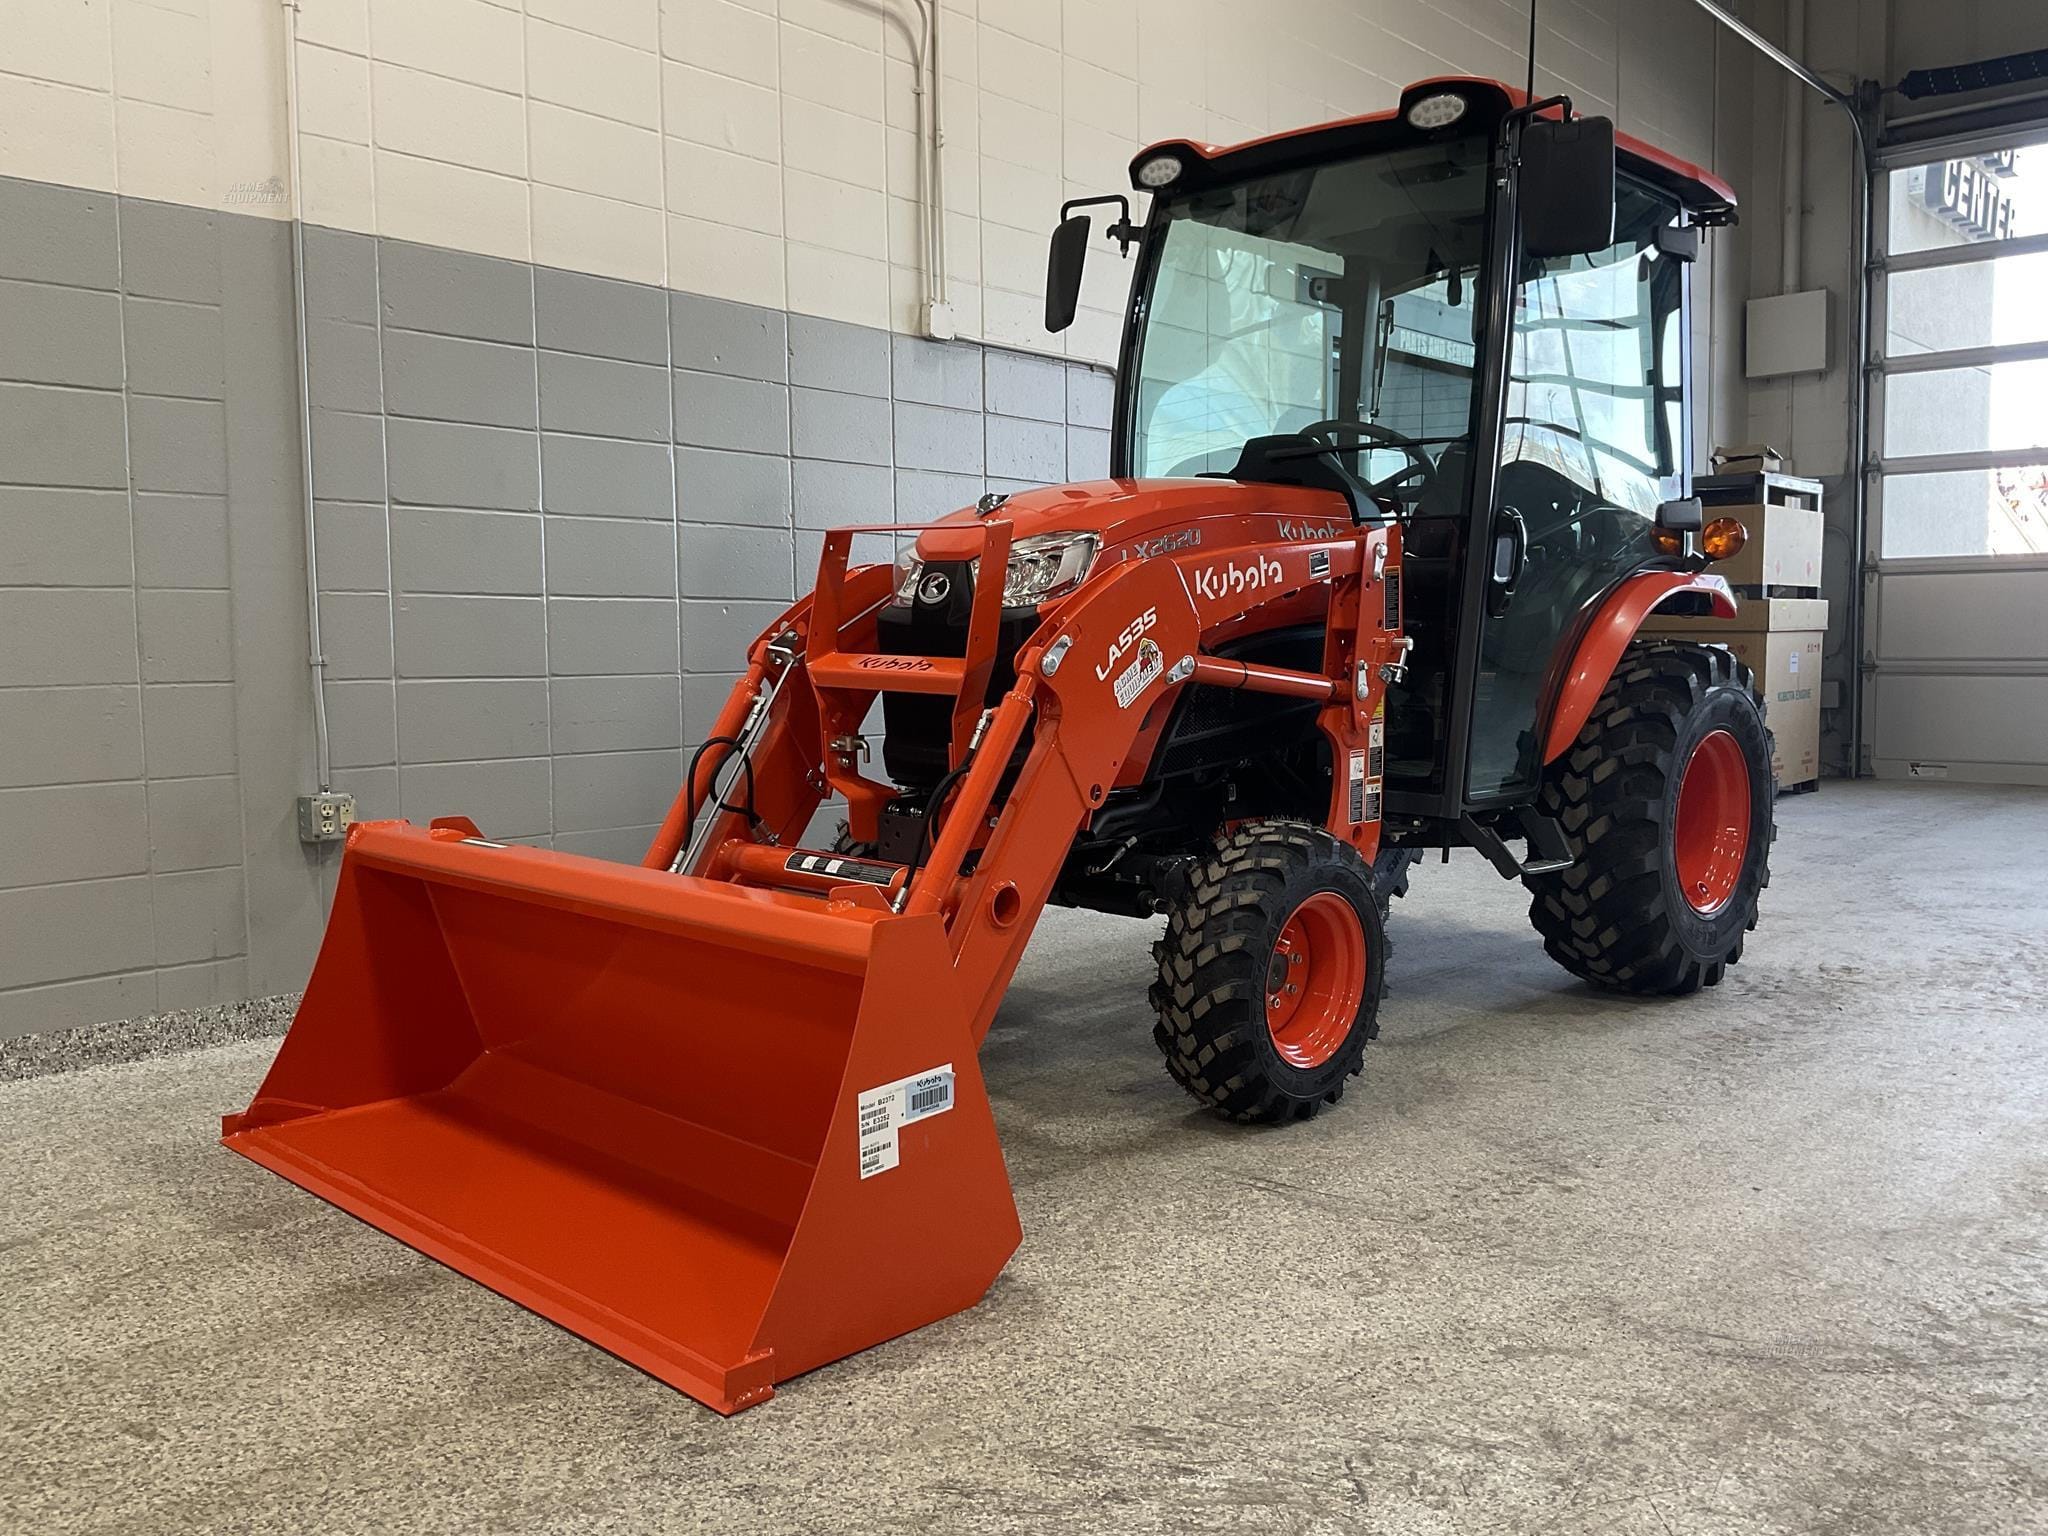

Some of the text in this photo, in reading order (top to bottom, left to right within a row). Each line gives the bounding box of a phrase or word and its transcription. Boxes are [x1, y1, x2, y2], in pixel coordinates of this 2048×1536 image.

[1944, 160, 2016, 240] CENTER
[1400, 329, 1427, 354] PARTS
[1428, 337, 1445, 358] AND
[1194, 554, 1284, 601] Kubota
[1095, 606, 1157, 681] LA535
[858, 656, 934, 671] Kubota
[1115, 663, 1140, 694] ACME
[1117, 654, 1164, 705] EQUIPMENT
[916, 1075, 942, 1088] Kubota
[873, 1114, 890, 1125] E3252
